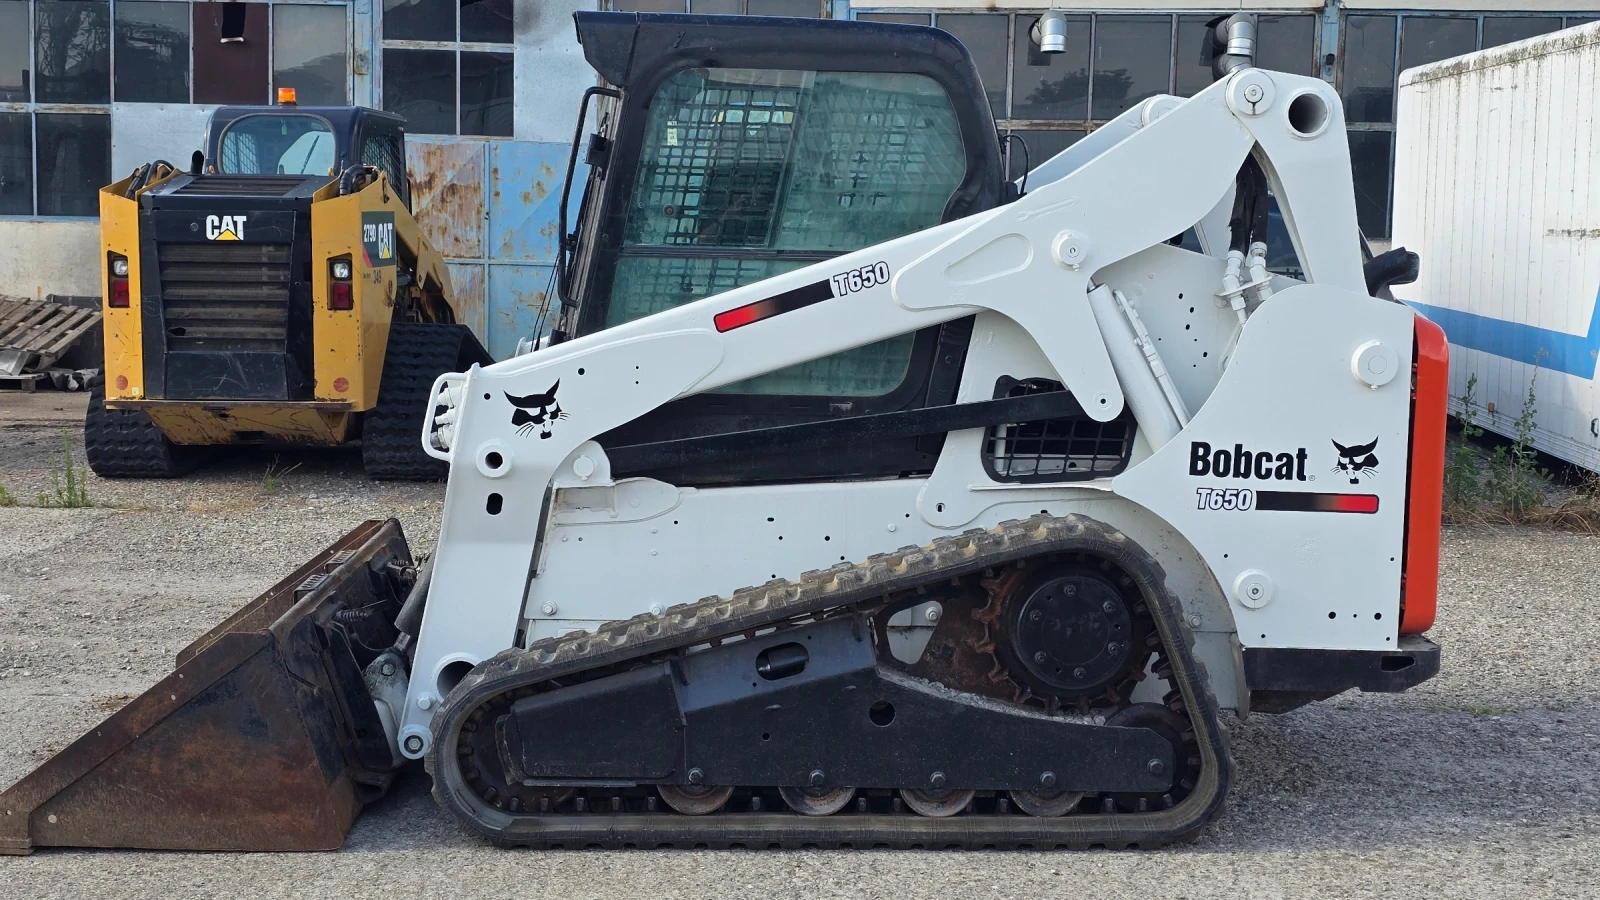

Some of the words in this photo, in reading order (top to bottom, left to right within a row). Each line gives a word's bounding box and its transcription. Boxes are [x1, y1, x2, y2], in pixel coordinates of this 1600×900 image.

[206, 214, 247, 241] CAT
[363, 223, 377, 243] 279D
[378, 222, 393, 259] CAT
[833, 261, 890, 297] T650
[1189, 441, 1308, 481] Bobcat
[1196, 487, 1253, 512] T650
